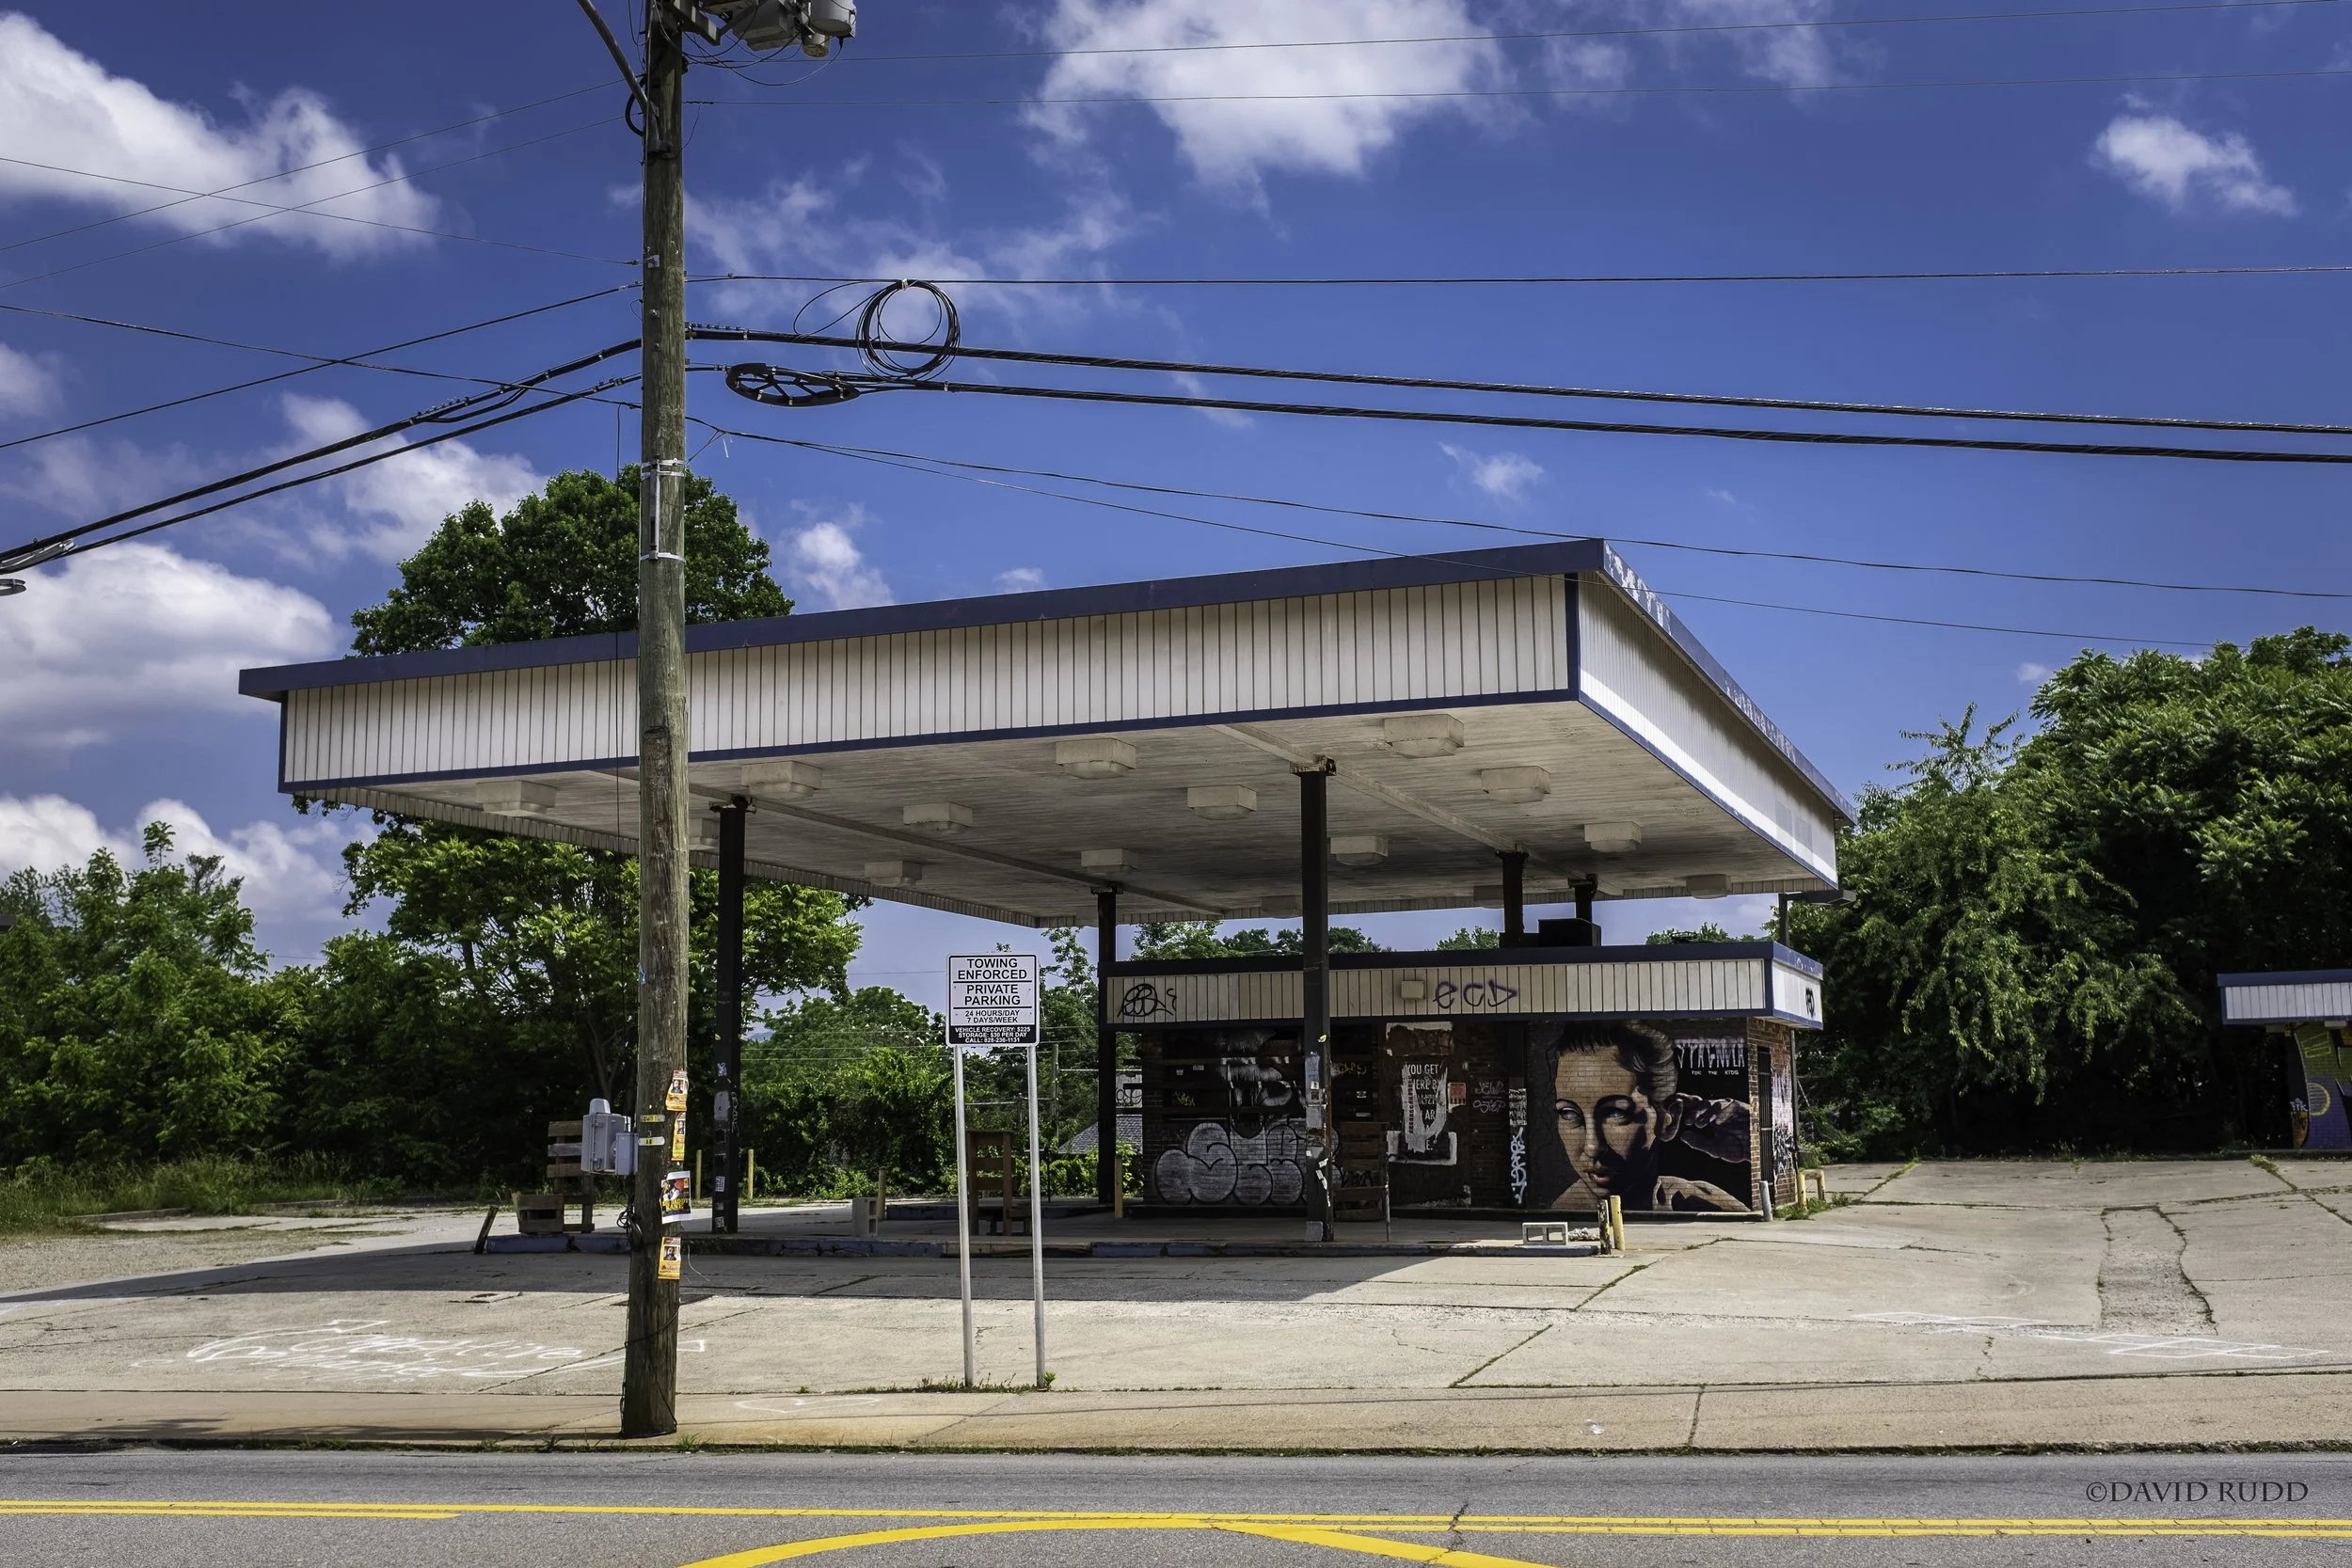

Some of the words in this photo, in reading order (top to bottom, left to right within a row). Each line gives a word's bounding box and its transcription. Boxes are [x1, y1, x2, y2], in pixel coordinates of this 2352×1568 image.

[967, 958, 1018, 969] TOWING
[958, 969, 1027, 980] ENFORCED
[967, 984, 1019, 995] PRIVATE
[964, 995, 1021, 1006] PARKING
[1423, 1063, 1439, 1075] GET
